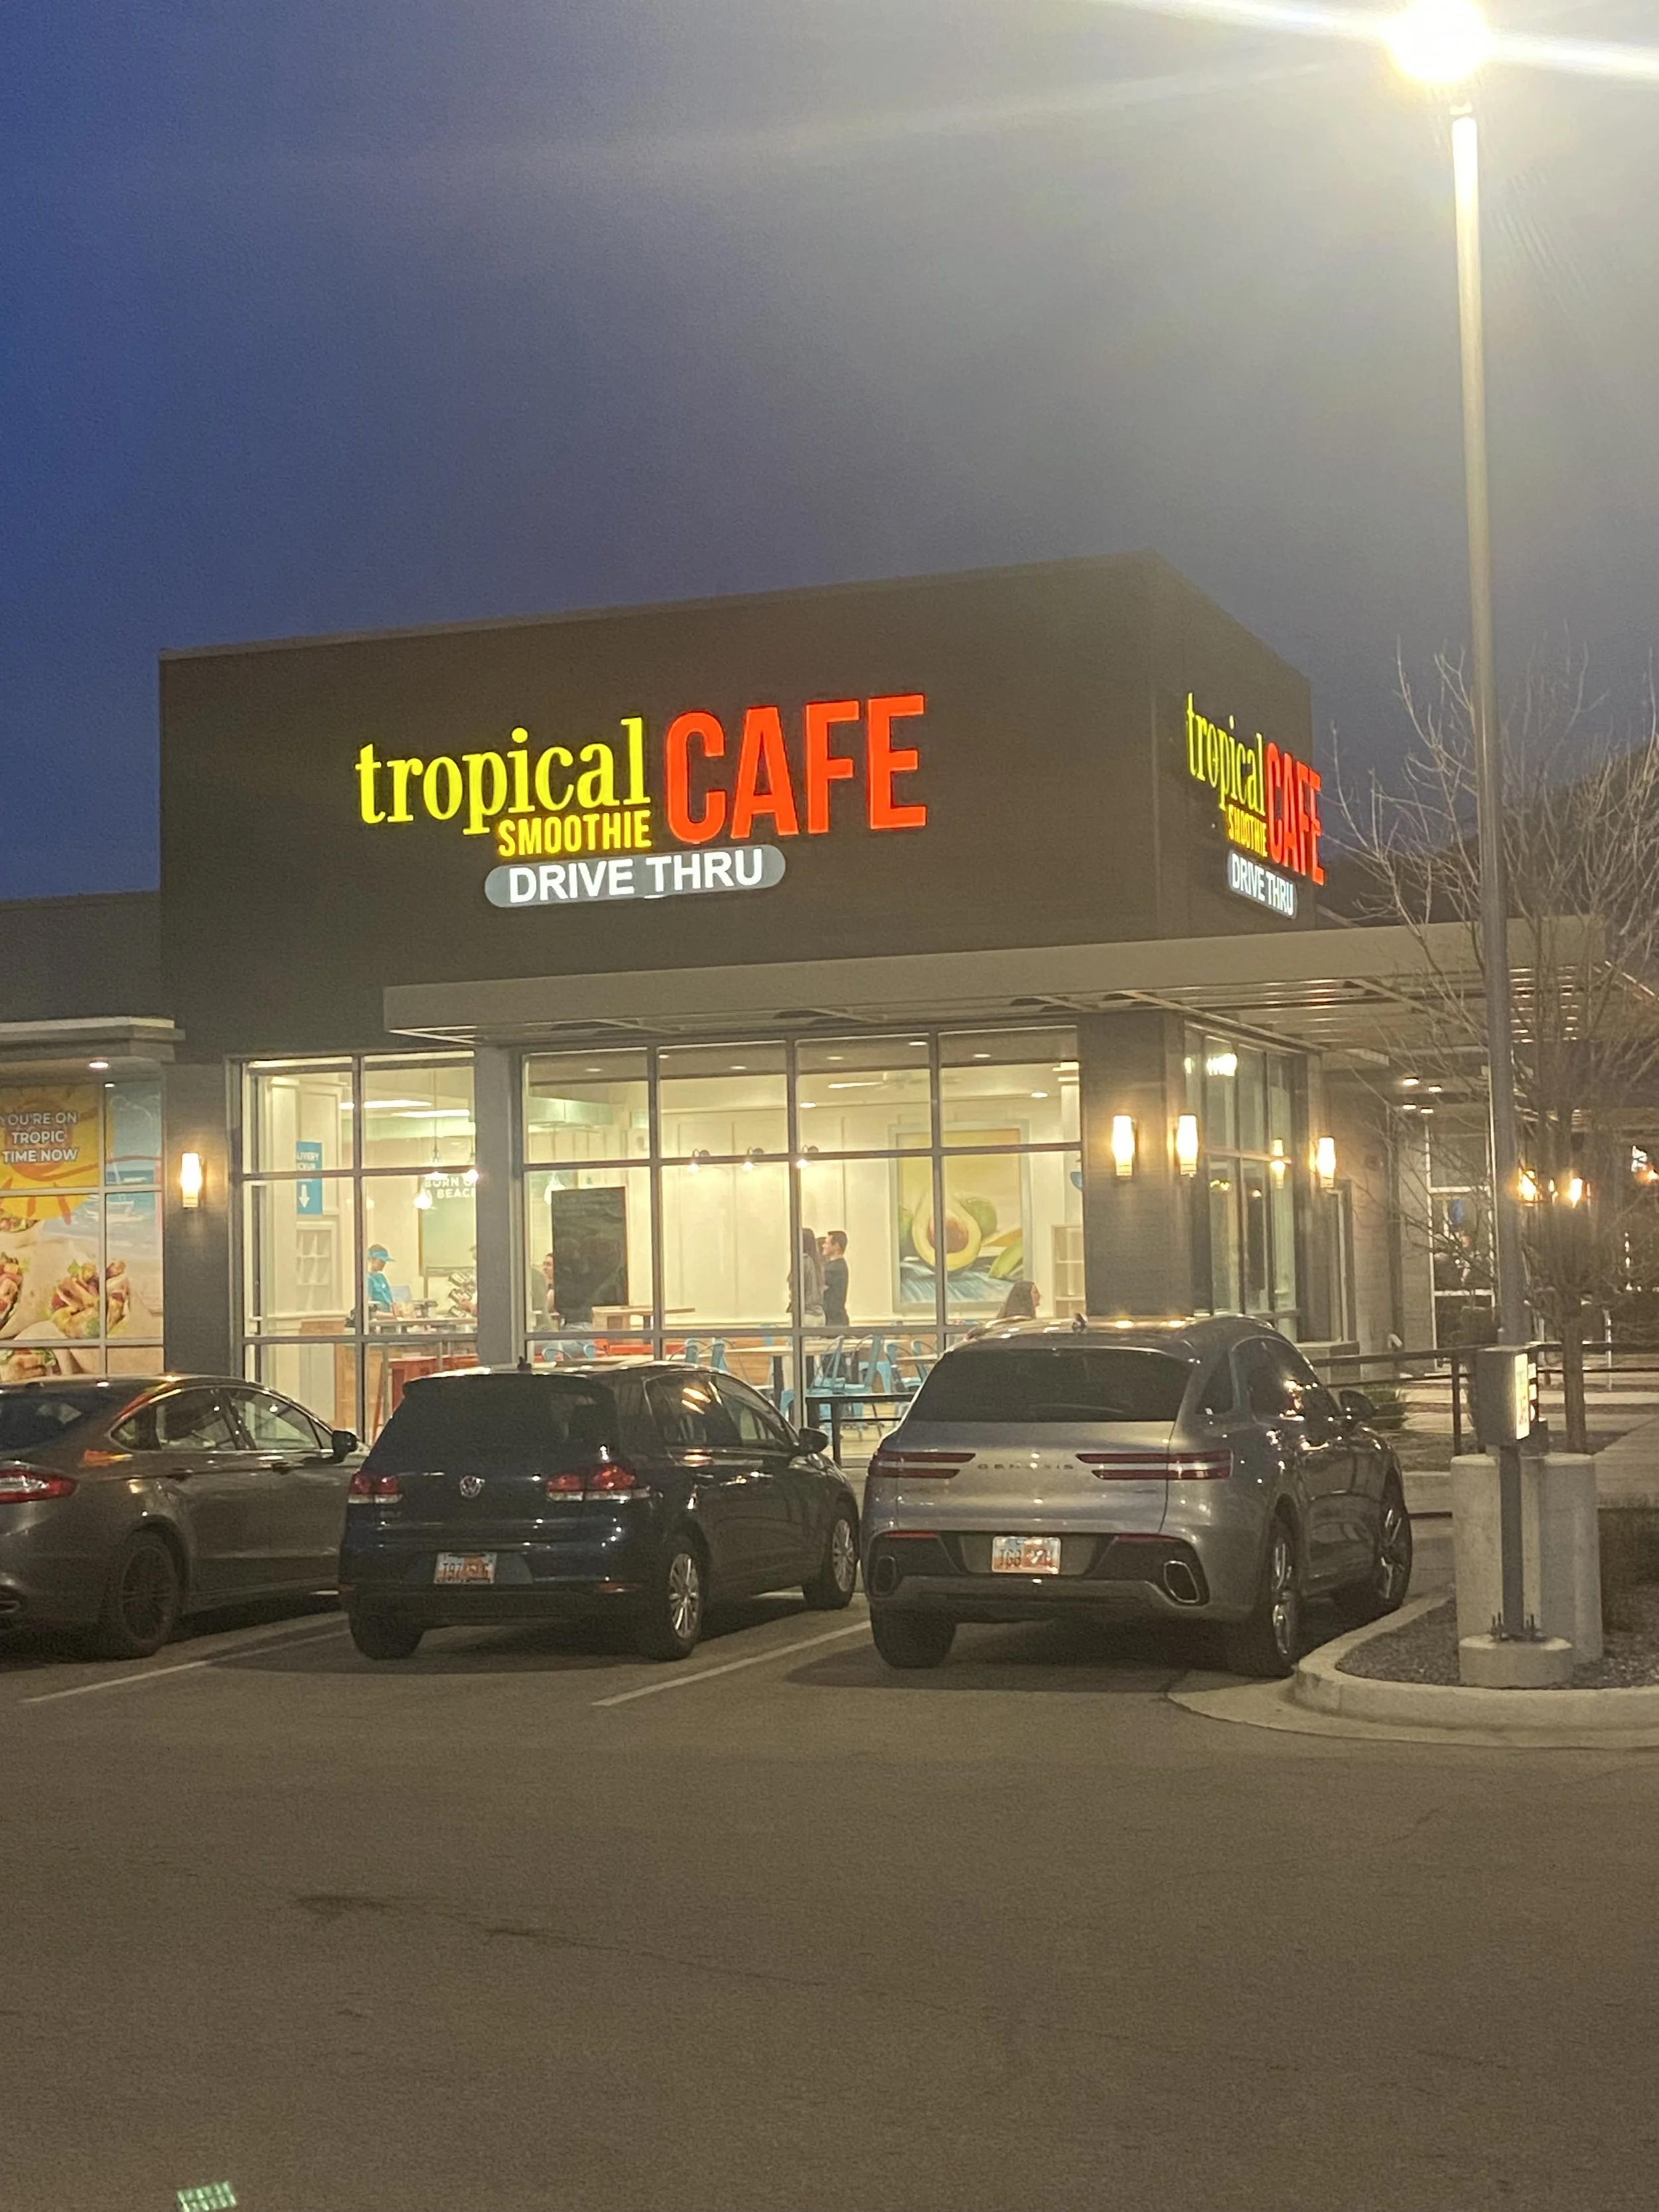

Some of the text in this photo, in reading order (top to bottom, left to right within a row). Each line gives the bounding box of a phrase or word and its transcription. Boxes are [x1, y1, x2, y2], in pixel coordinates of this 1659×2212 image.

[355, 717, 651, 835] tropical
[665, 694, 927, 842] CAFE
[1187, 692, 1265, 816] tropical
[497, 810, 652, 857] SMOOTHIE
[1265, 742, 1325, 886] CAFE
[509, 848, 763, 903] DRIVE THRU
[1232, 853, 1294, 916] DRIVE THRU
[11, 1130, 65, 1144] TROPIC
[55, 1112, 78, 1124] ON
[2, 1148, 78, 1163] TIME NOW
